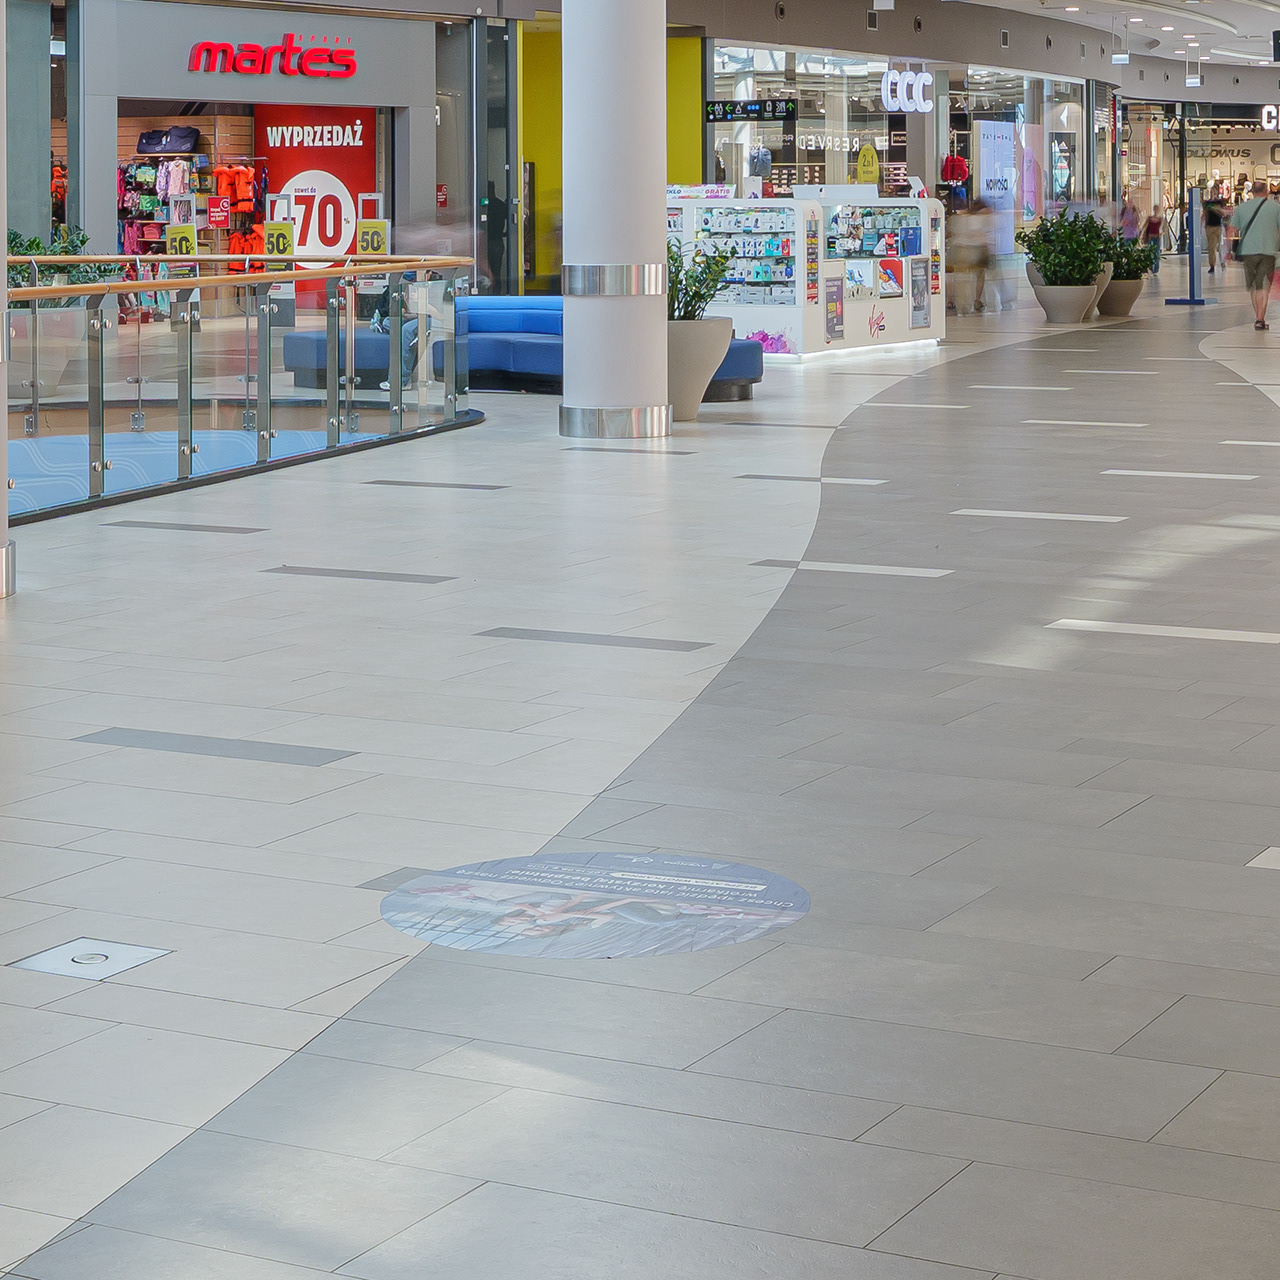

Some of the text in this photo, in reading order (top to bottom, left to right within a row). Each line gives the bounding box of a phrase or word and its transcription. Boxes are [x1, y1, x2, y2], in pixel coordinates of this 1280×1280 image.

[188, 33, 357, 78] martes
[881, 69, 934, 113] CCC
[266, 119, 363, 147] WYPRZEDAŻ
[563, 880, 642, 894] aktywnie?
[592, 877, 667, 891] korzystaj
[643, 888, 673, 897] lato
[738, 897, 795, 908] Chcesz
